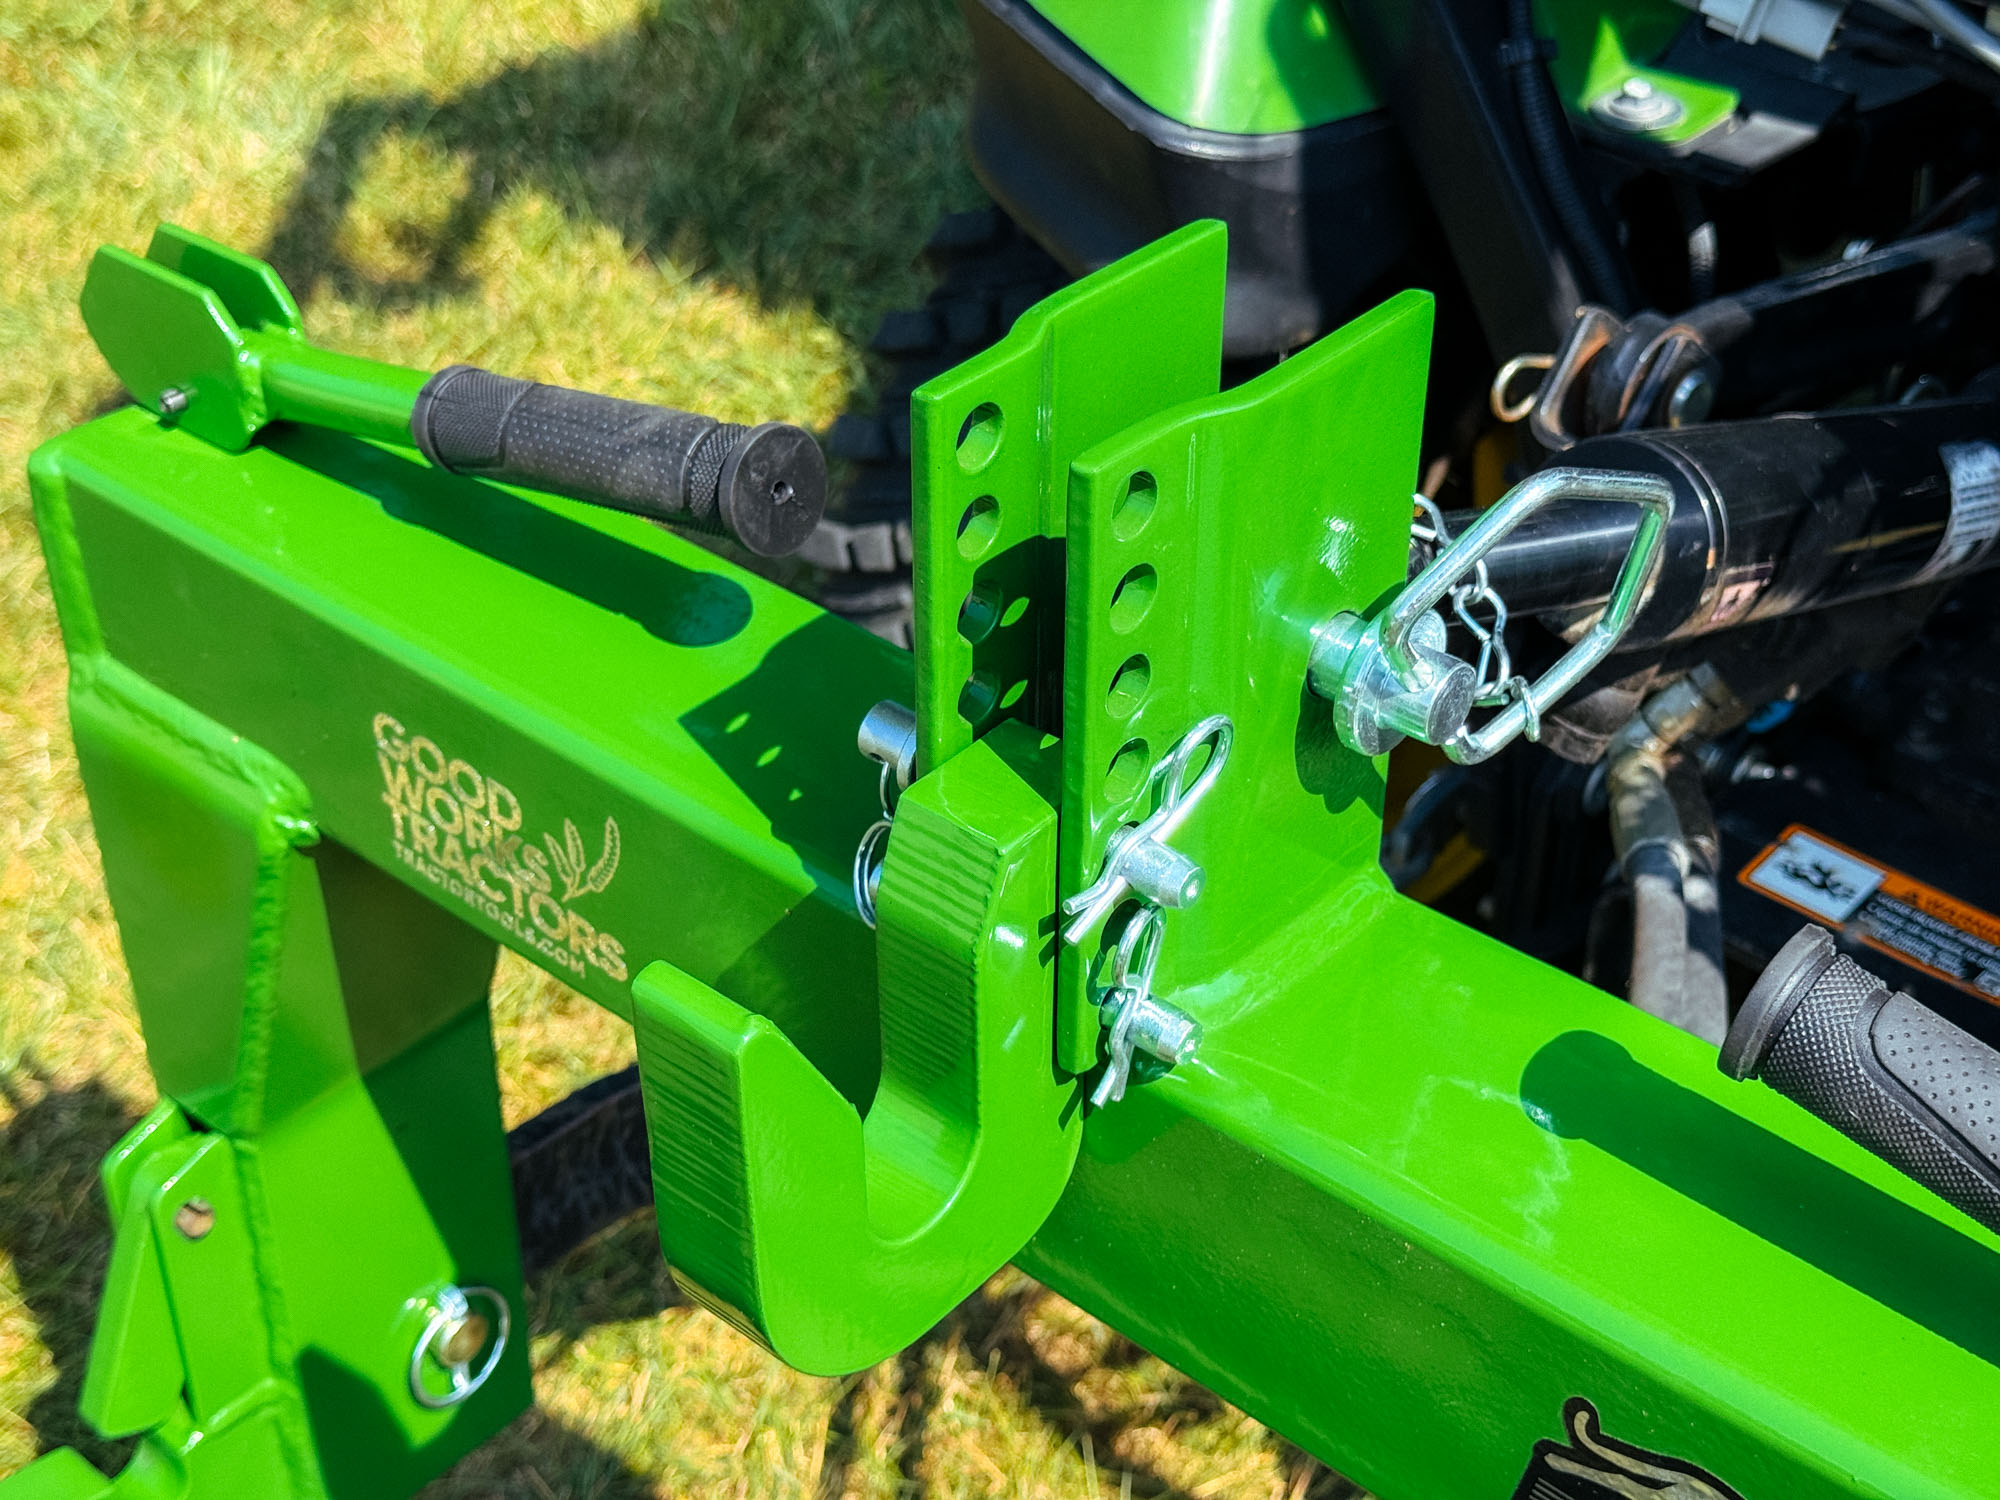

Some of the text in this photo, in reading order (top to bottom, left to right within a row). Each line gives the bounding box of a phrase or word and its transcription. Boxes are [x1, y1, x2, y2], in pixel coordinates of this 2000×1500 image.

[373, 712, 523, 832] GOOD
[378, 750, 552, 893] WORKS
[382, 791, 628, 982] TRACTORS
